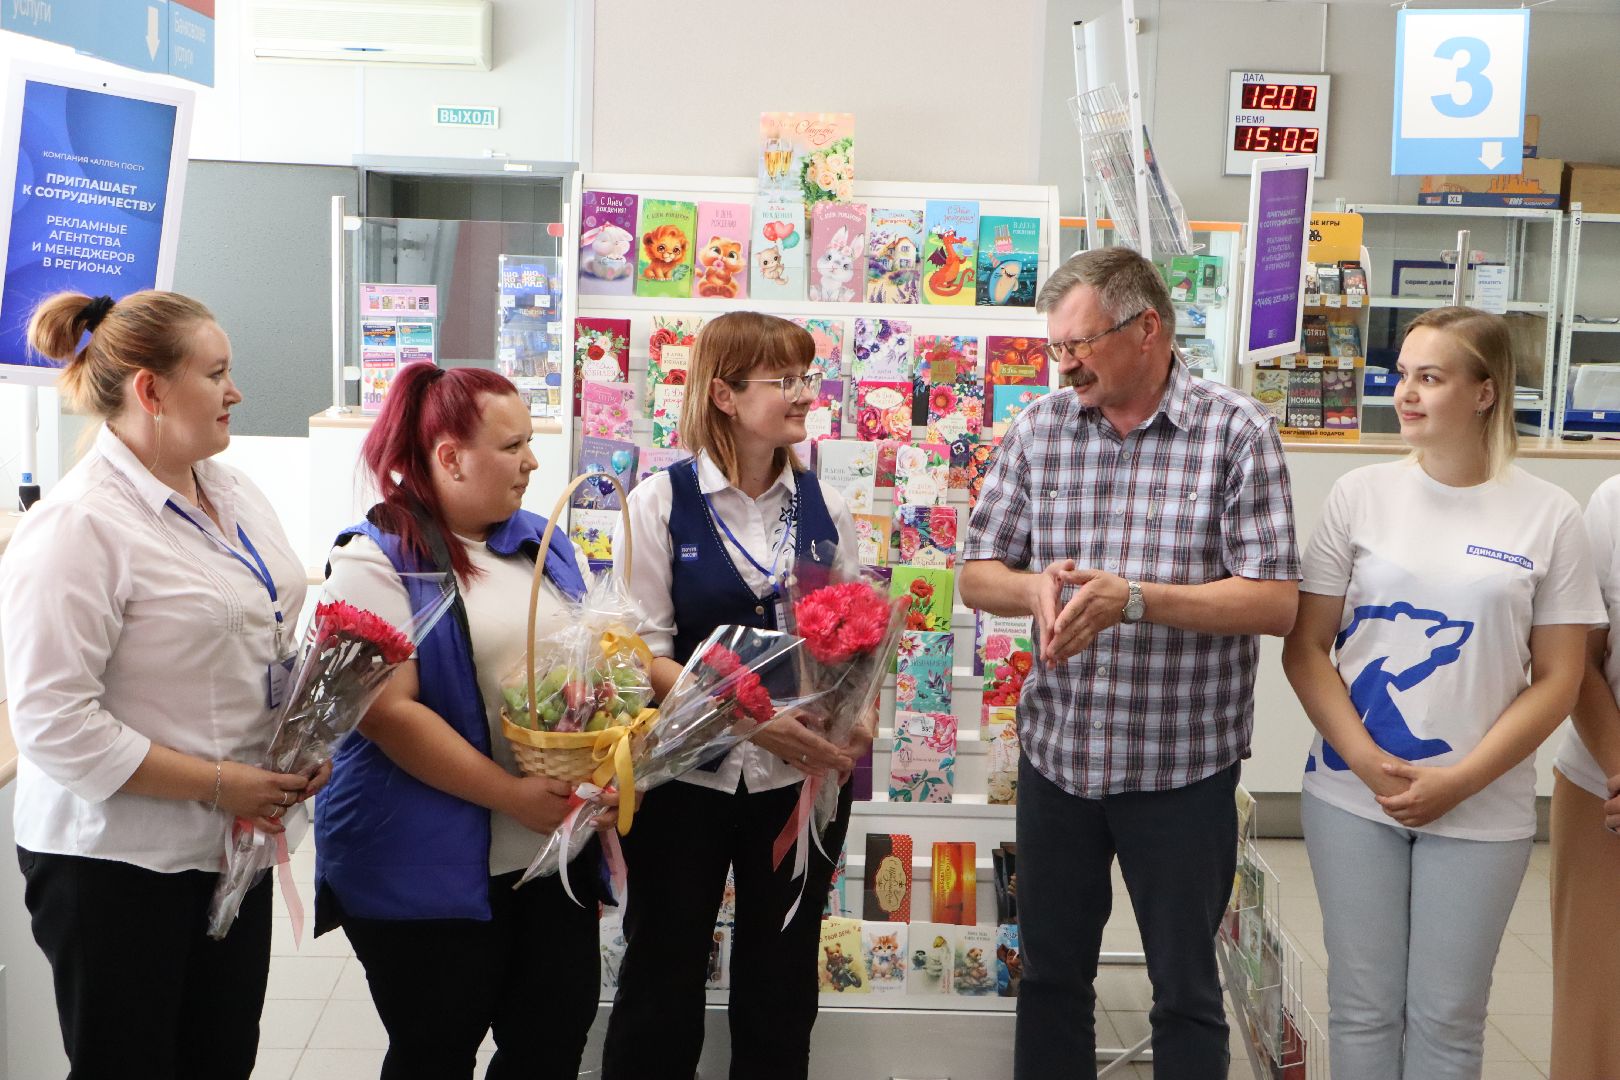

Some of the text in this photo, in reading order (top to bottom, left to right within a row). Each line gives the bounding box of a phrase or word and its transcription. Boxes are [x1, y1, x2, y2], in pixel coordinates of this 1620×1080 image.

[1242, 73, 1265, 82] ДАТА
[1430, 36, 1494, 119] 3
[1252, 85, 1316, 109] 12.07
[440, 109, 493, 126] ВЫХОД
[1235, 115, 1265, 124] ВРЕМЯ
[1245, 127, 1319, 152] 15:02
[43, 150, 89, 164] КОМПАНИЯ
[45, 172, 138, 196] ПРИГЛАШАЕТ
[22, 184, 157, 212] К СОТРУДНИЧЕСТВУ
[1450, 195, 1461, 204] XL
[46, 214, 128, 235] РЕКЛАМНЫЕ
[1575, 217, 1581, 226] 5
[48, 229, 122, 248] АГЕНТСТВА
[31, 241, 135, 263] И МЕНЕДЖЕРОВ
[43, 256, 122, 276] В РЕГИОНАХ
[1290, 397, 1321, 405] НОМИКА
[1468, 546, 1533, 569] ЕДИНАЯ РОССИЯ
